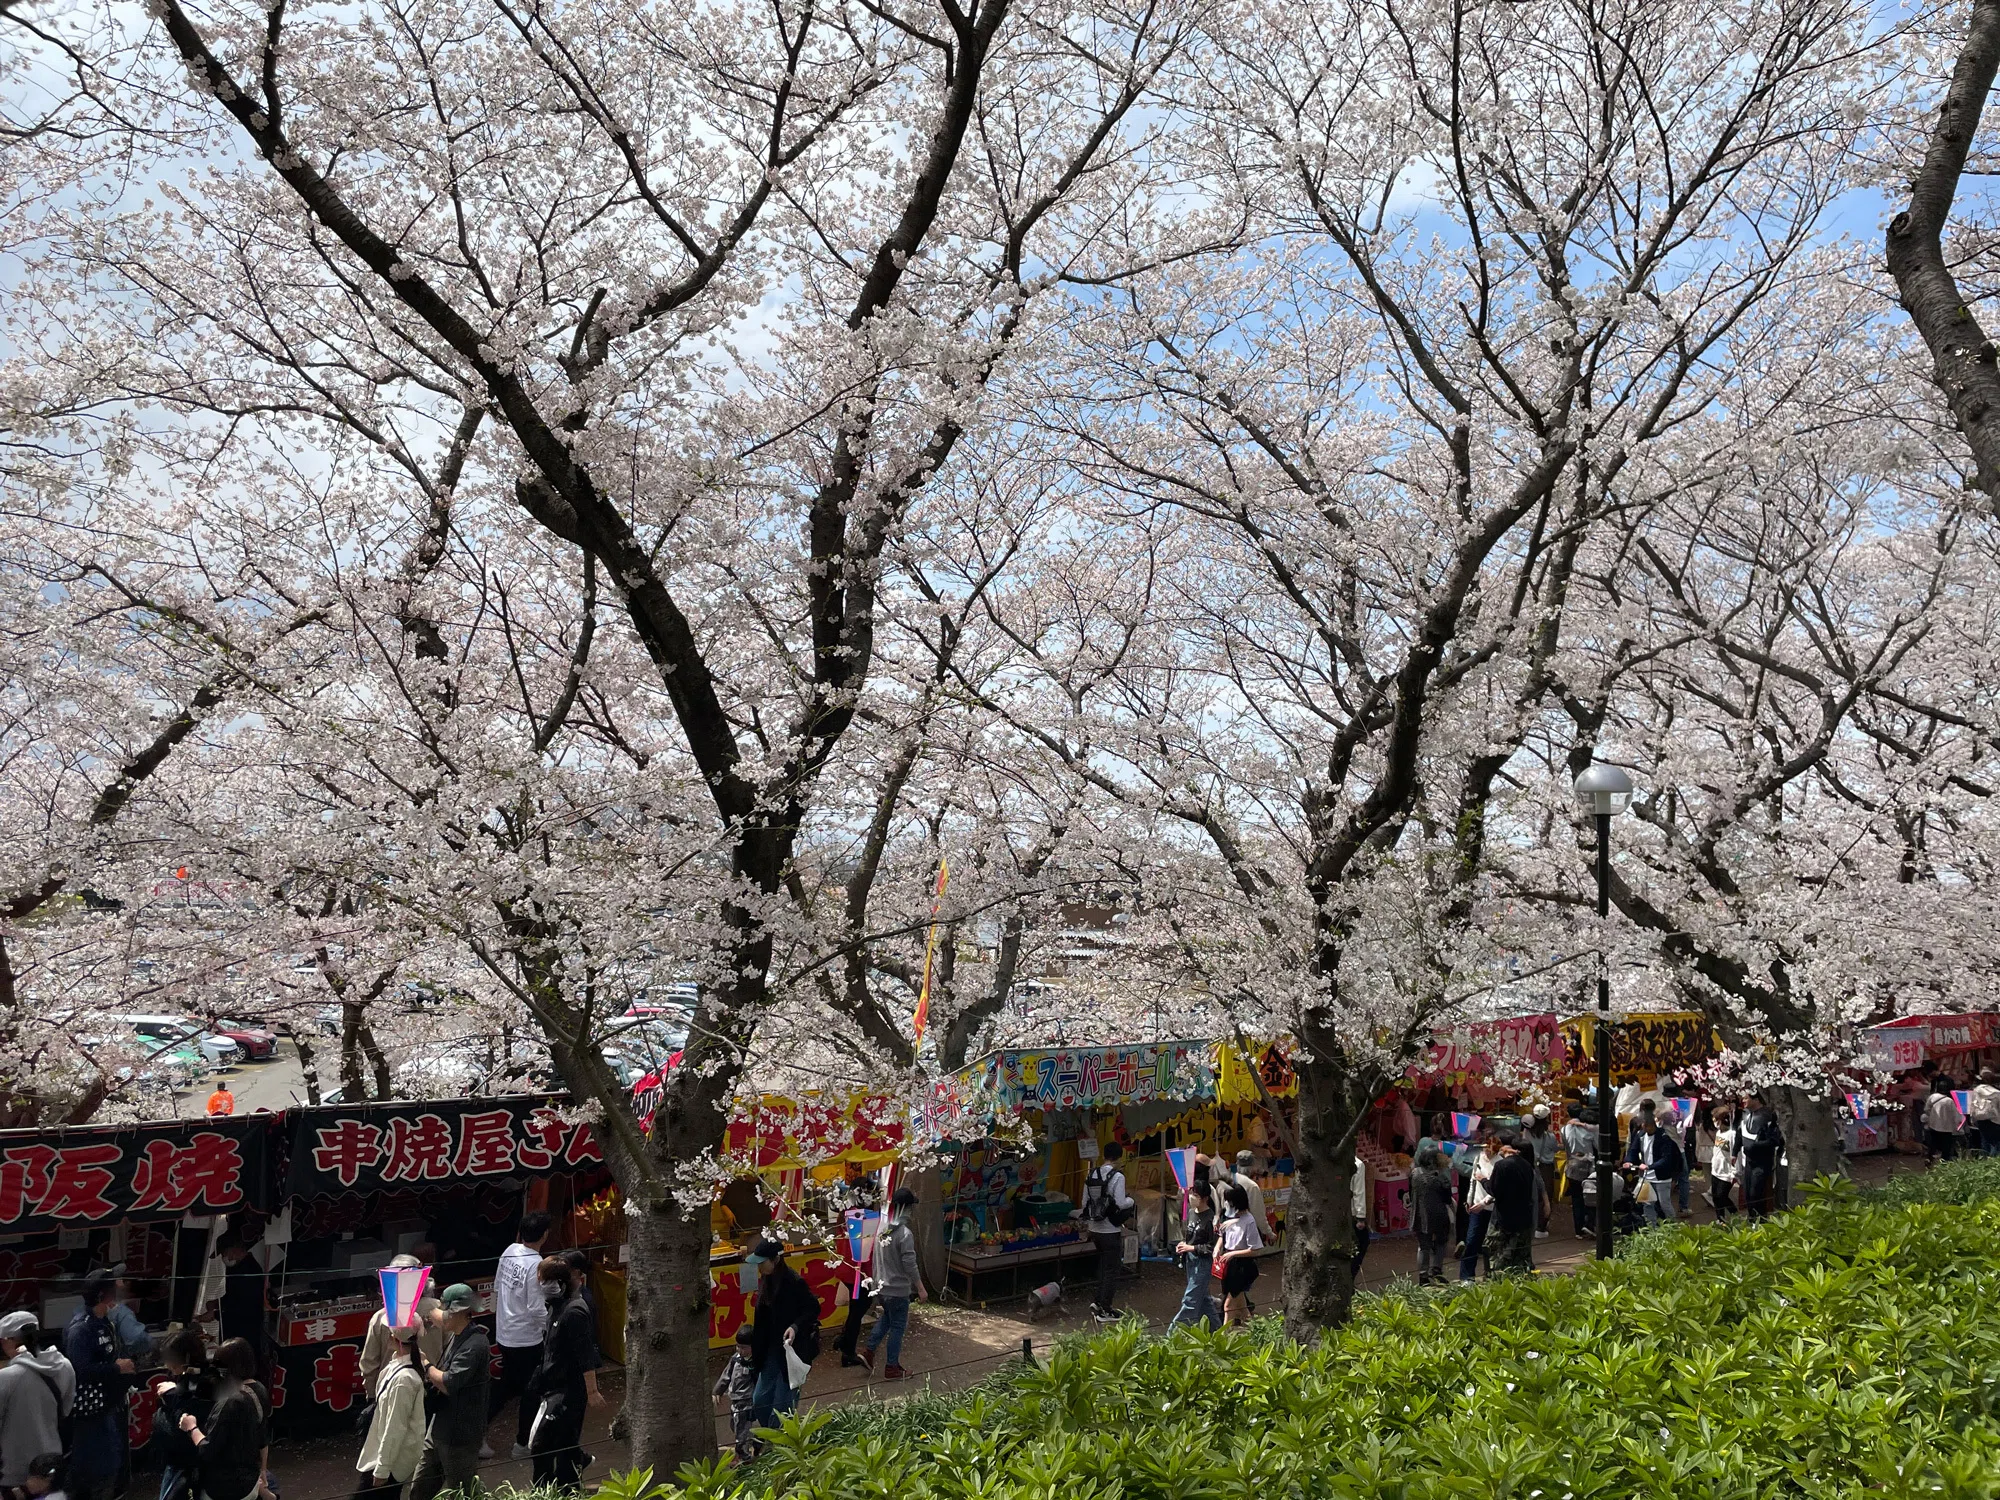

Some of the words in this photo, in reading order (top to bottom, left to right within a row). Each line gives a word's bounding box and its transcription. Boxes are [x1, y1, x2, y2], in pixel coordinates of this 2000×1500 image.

[1893, 1040, 1920, 1065] かき氷
[1037, 1050, 1174, 1102] スーパーボール
[304, 1318, 337, 1341] 串
